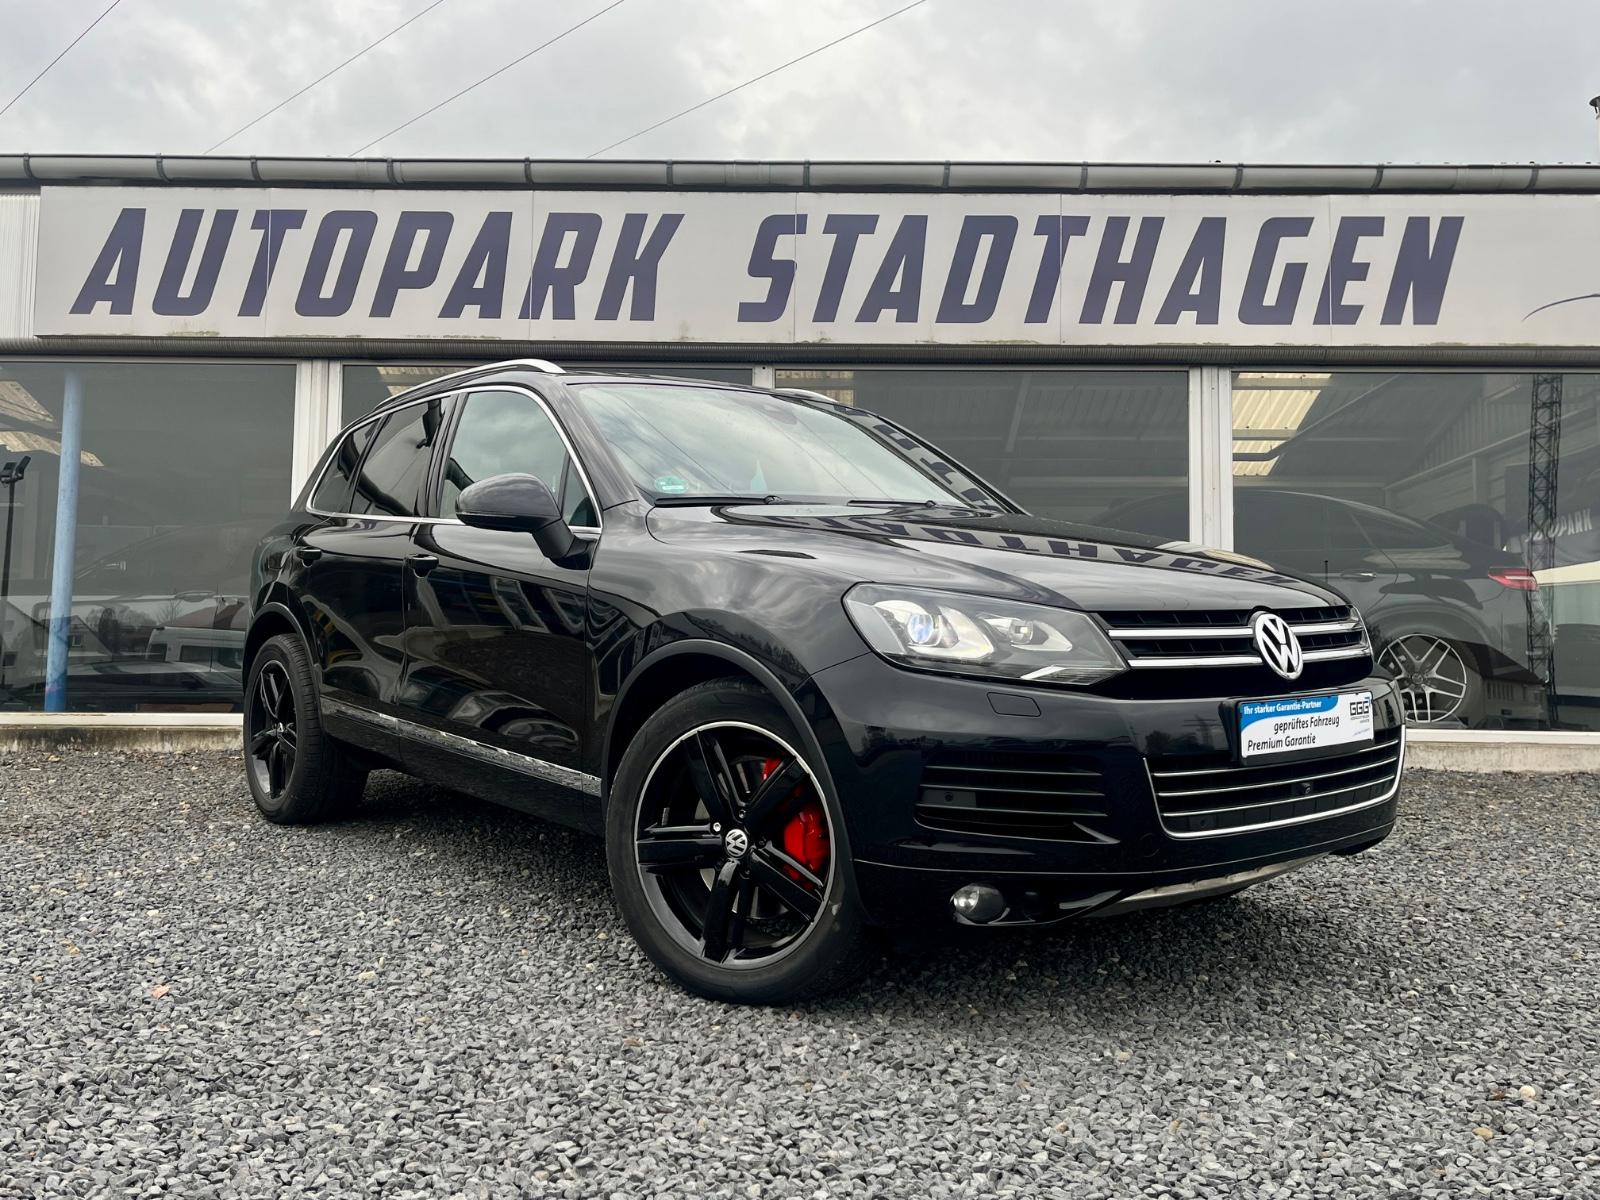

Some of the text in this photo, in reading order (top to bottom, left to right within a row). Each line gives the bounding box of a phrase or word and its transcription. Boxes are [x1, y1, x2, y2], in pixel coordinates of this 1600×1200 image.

[69, 207, 1466, 326] AUTOPARK STADTHAGEN
[1255, 613, 1303, 679] VW
[1243, 701, 1322, 715] Ihr starker Garantie-Partner
[1274, 715, 1340, 734] geprüftes Fahrzeug
[1247, 733, 1316, 751] Premium Garantie
